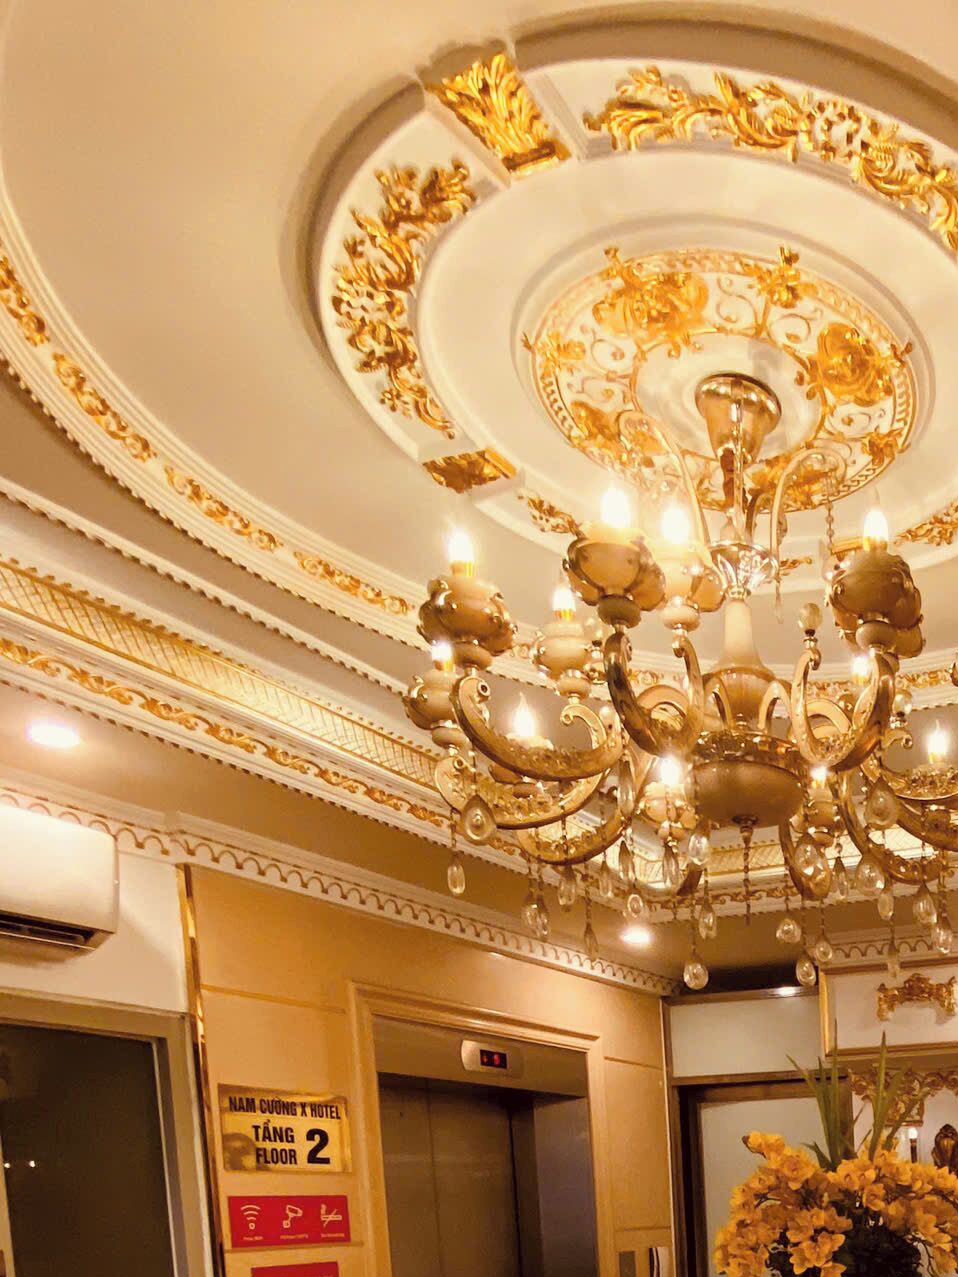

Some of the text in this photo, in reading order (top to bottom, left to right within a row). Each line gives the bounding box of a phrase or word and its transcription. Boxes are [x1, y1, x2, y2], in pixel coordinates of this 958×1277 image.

[228, 1096, 256, 1113] NAM
[301, 1101, 308, 1118] X
[310, 1102, 341, 1120] HOTEL
[255, 1147, 298, 1165] FLOOR
[305, 1128, 331, 1165] 2
